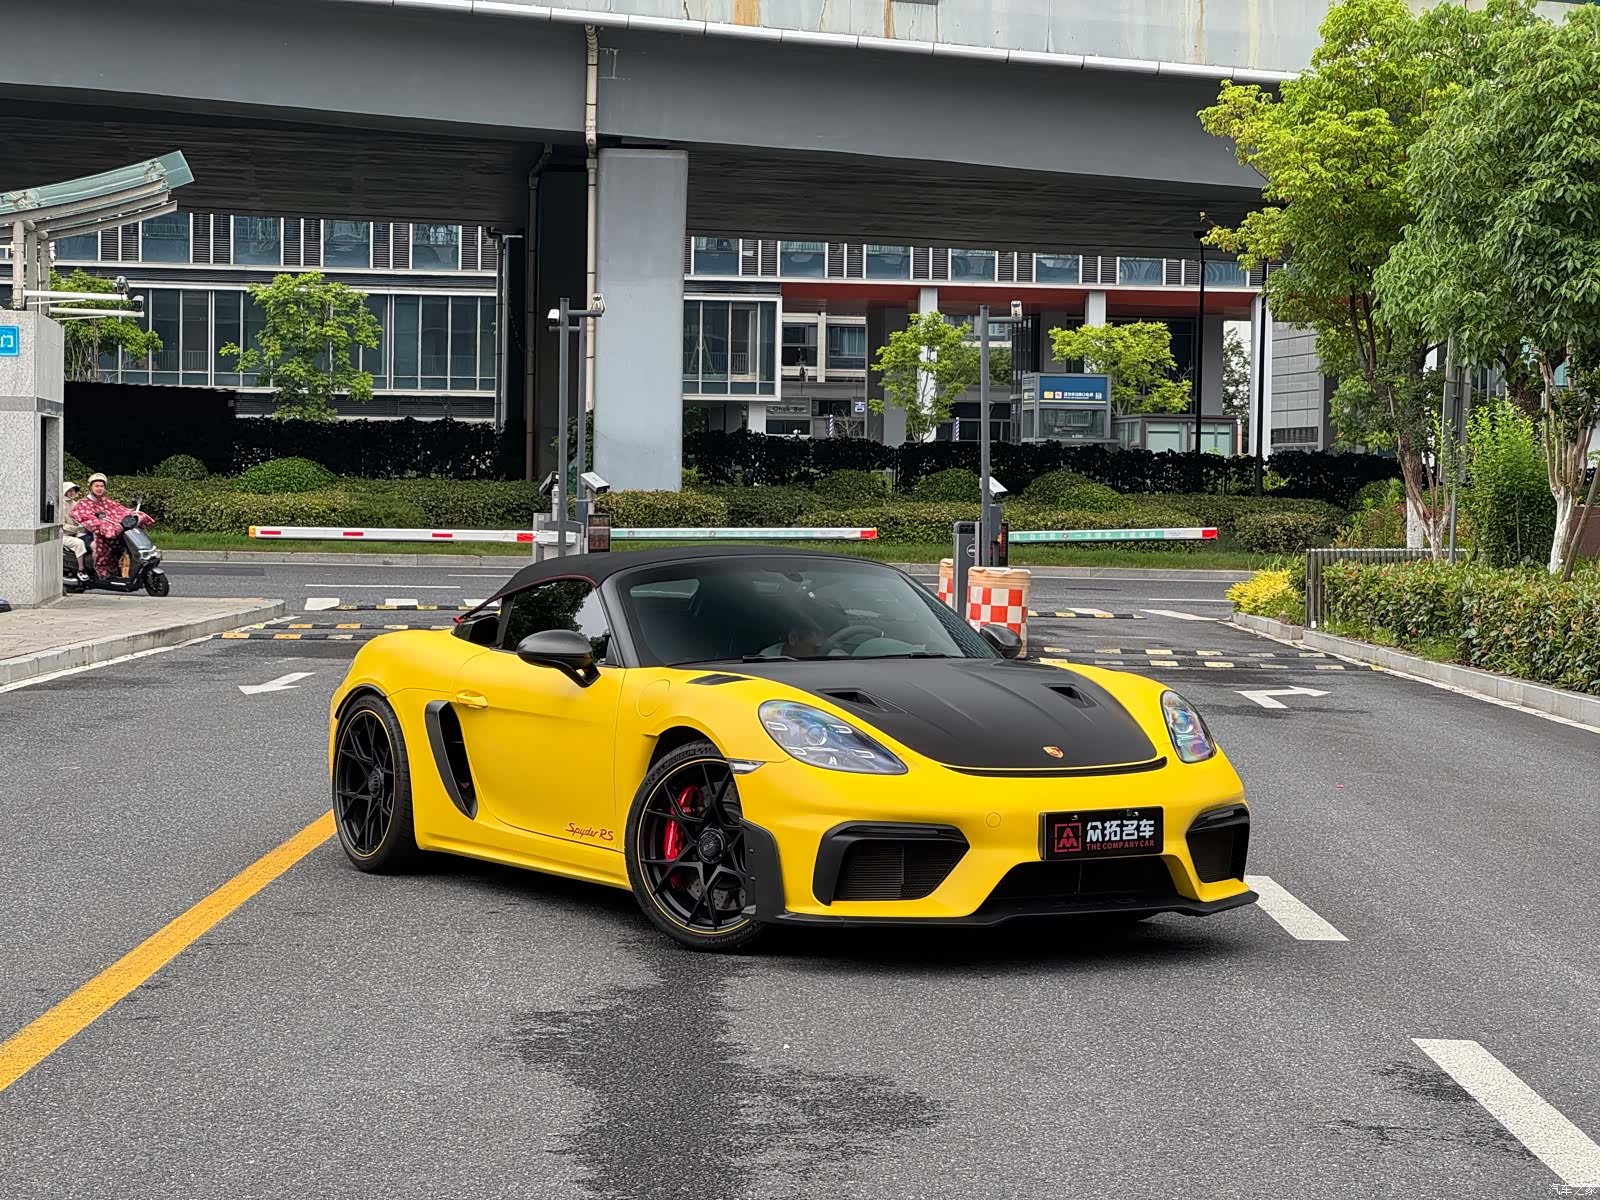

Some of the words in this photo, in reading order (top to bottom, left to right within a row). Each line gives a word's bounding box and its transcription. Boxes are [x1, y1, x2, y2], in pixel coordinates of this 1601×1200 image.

[0, 334, 14, 348] 门
[565, 822, 598, 839] Spyder
[599, 828, 614, 841] RS
[1086, 819, 1155, 842] 众拓名车
[1086, 843, 1101, 851] THE
[1102, 841, 1139, 850] COMPANY
